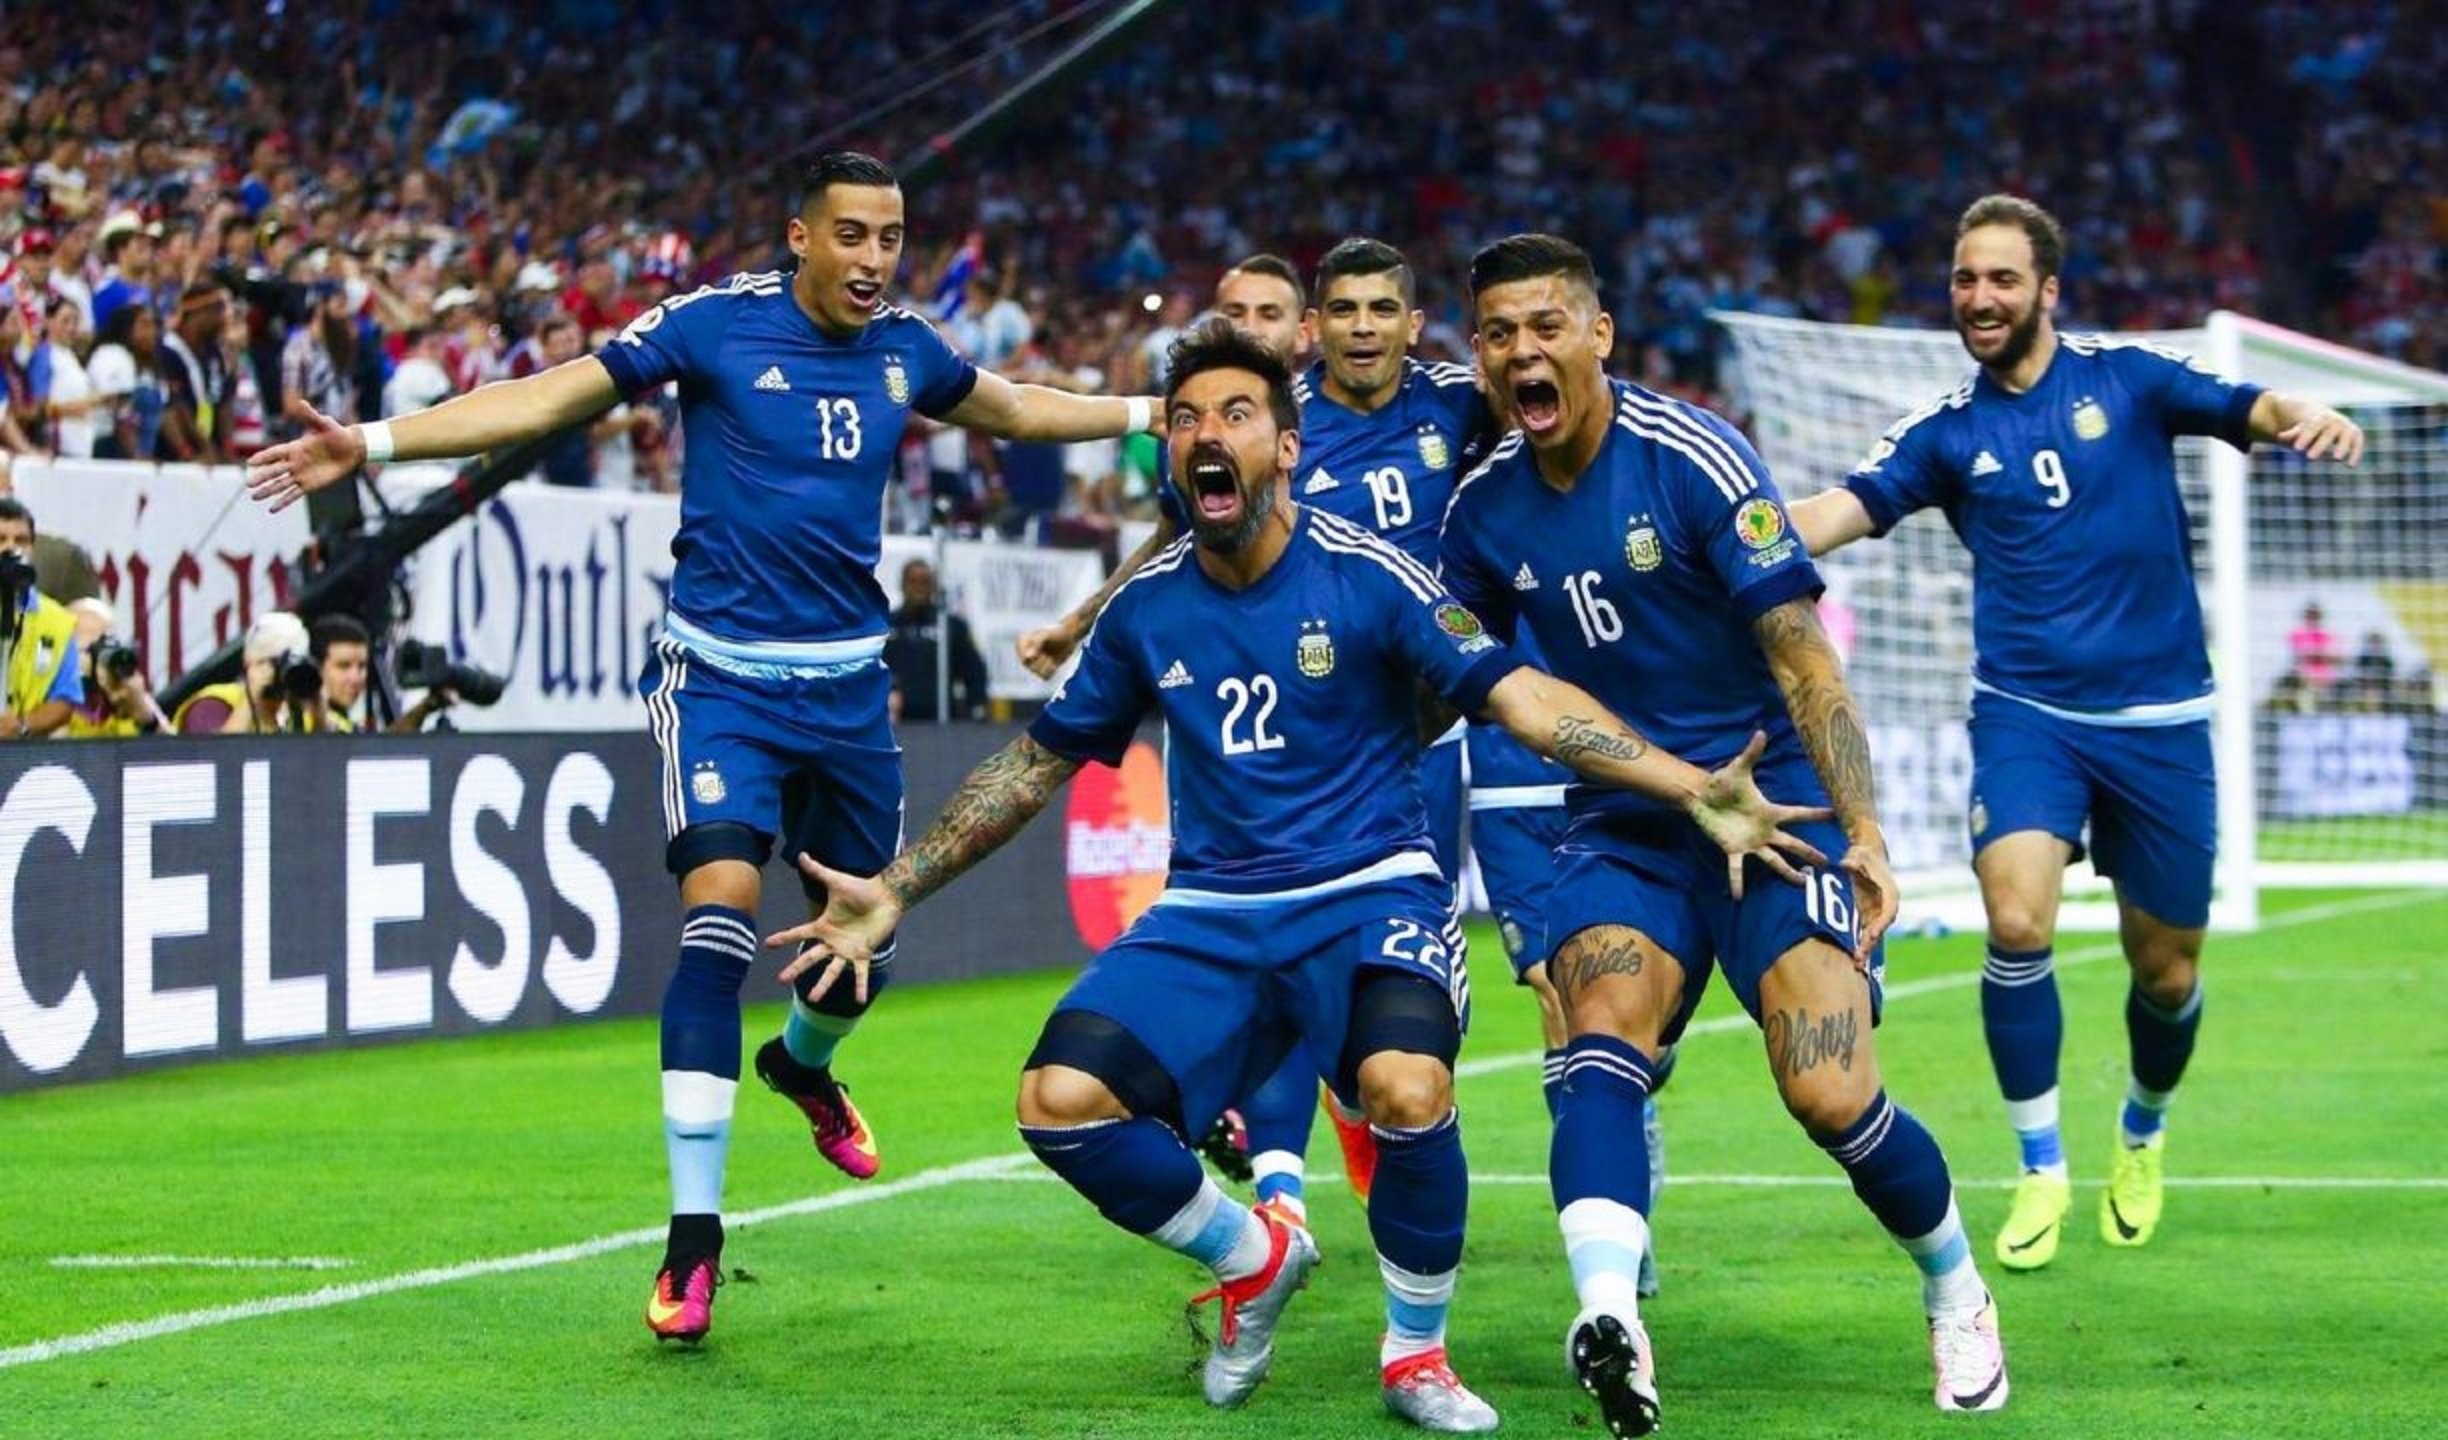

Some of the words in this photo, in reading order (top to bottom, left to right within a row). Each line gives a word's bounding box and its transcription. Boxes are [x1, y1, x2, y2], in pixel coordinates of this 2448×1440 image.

[815, 397, 862, 460] 13
[1361, 465, 1414, 530] 19
[2031, 449, 2072, 508] 9
[1562, 569, 1625, 649] 16
[1216, 673, 1286, 756] 22
[0, 752, 622, 1074] CELESS
[1800, 864, 1851, 933] 16
[1382, 917, 1447, 979] 22
